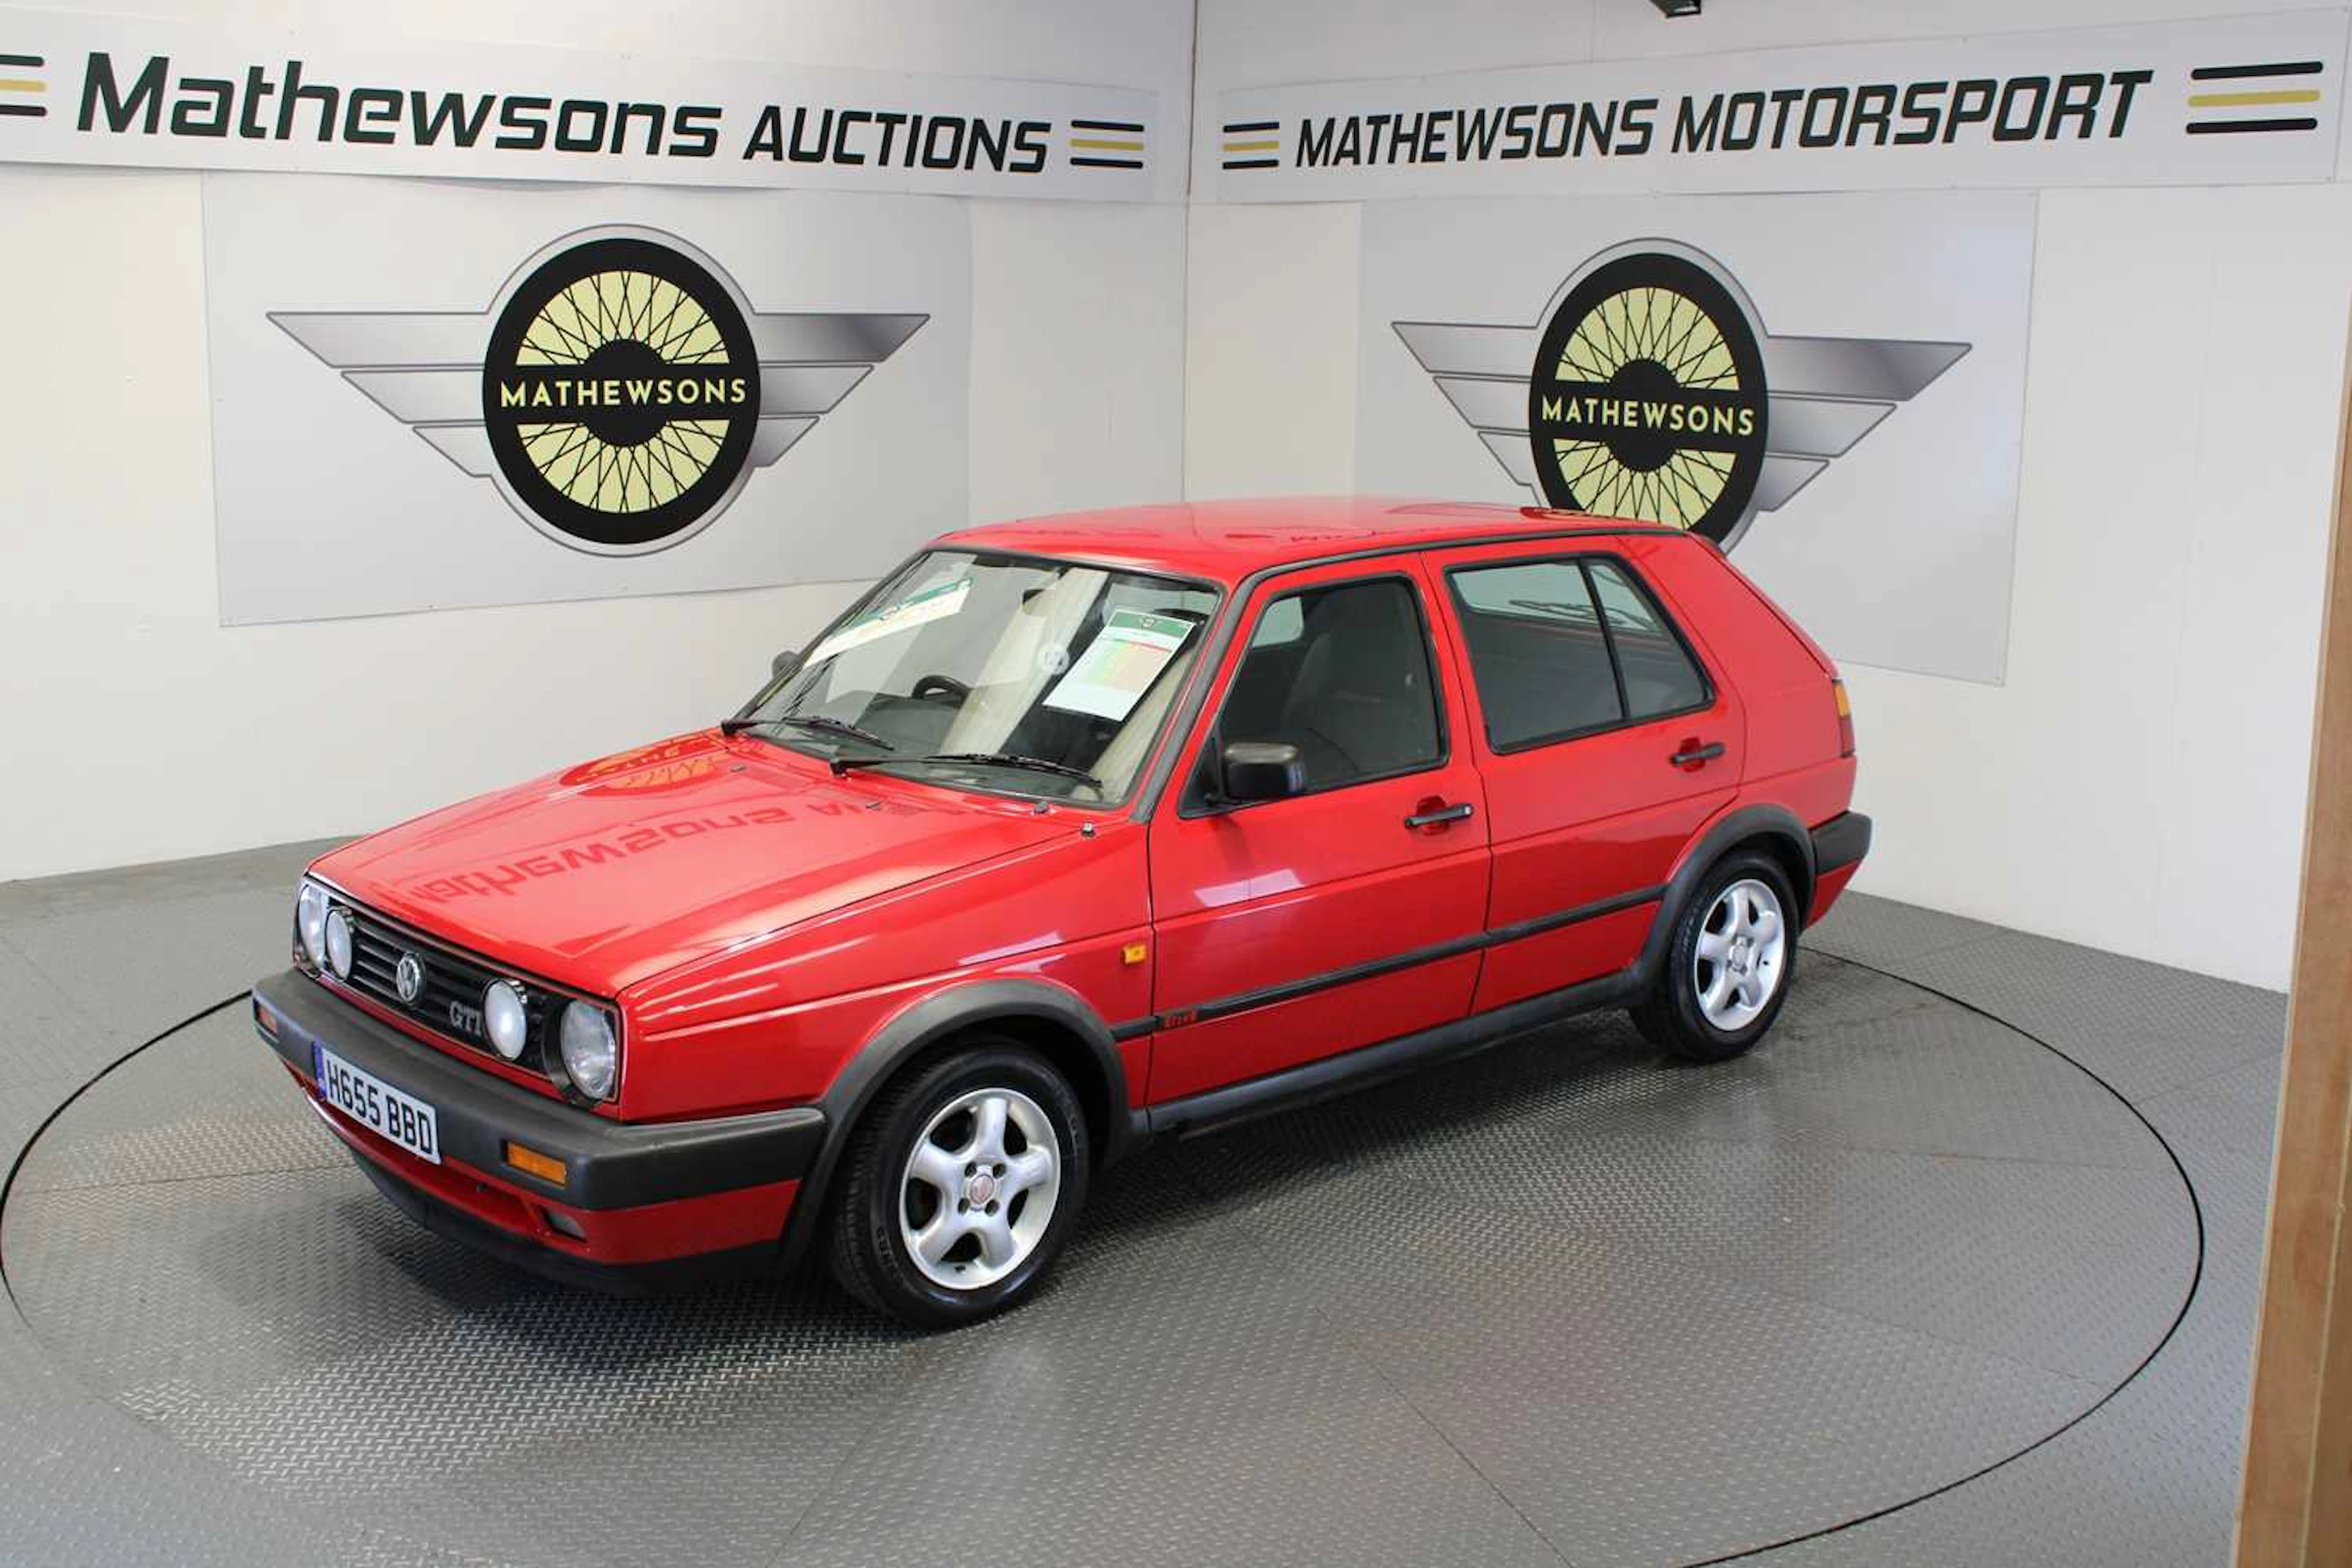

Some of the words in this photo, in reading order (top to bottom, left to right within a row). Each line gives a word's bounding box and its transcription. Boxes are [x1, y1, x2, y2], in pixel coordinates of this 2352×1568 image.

[77, 51, 723, 157] Mathewsons
[742, 105, 1052, 173] AUCTIONS
[1295, 99, 1659, 168] MATHEWSONS
[1671, 69, 2154, 153] MOTORSPORT
[500, 379, 746, 408] MATHEWSONS
[1542, 395, 1754, 436] MATHEWSONS
[449, 1000, 482, 1036] GTI
[326, 1059, 381, 1126] H655
[385, 1095, 433, 1155] BBD
